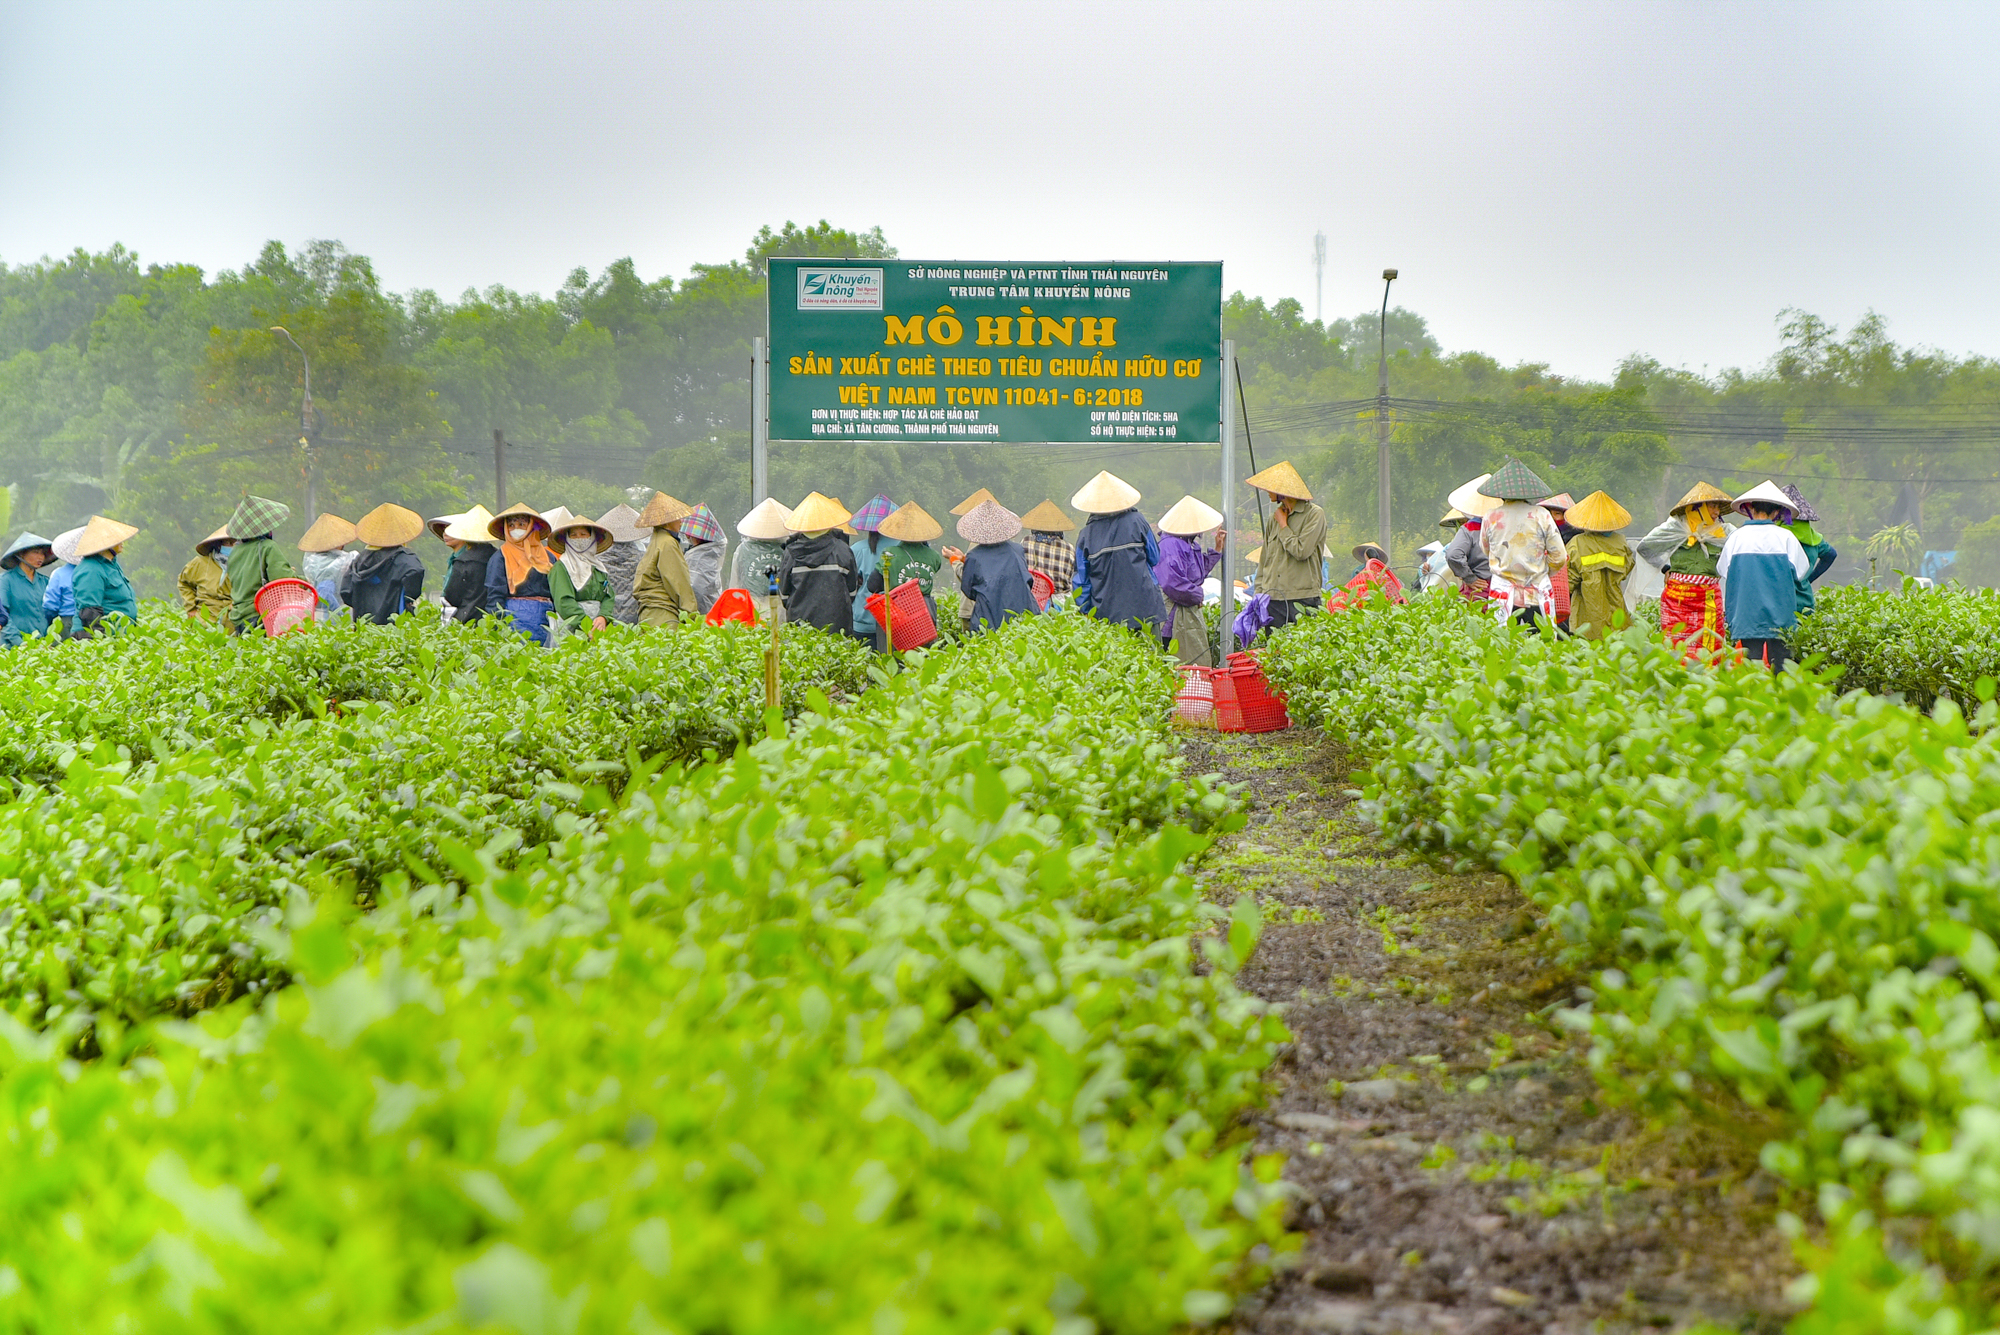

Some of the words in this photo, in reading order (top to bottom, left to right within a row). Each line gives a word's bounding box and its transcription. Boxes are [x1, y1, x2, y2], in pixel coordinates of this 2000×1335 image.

[829, 273, 871, 287] Khuyến
[908, 265, 925, 279] SỞ
[927, 267, 961, 279] NÔNG
[963, 267, 1007, 281] NGHIỆP
[1010, 267, 1026, 279] VÀ
[1028, 269, 1058, 280] PTNT
[1061, 266, 1088, 280] TỈNH
[1091, 268, 1118, 280] THÁI
[1120, 268, 1168, 280] NGUYÊN
[825, 285, 855, 298] nông
[948, 286, 995, 297] TRUNG
[999, 284, 1030, 297] TÂM
[1033, 283, 1090, 298] KHUYẾN
[1094, 284, 1131, 298] NÔNG
[883, 304, 963, 346] MÔ
[975, 306, 1117, 347] HÌNH
[789, 350, 833, 375] SẢN
[839, 351, 891, 375] XUẤT
[896, 354, 936, 376] CHÈ
[941, 357, 992, 376] THEO
[998, 355, 1042, 377] TIÊU
[1049, 351, 1118, 377] CHUẨN
[1125, 354, 1167, 378] HỮU
[1173, 358, 1202, 378] CƠ
[838, 382, 881, 407] VIỆT
[888, 386, 936, 405] NAM
[944, 386, 999, 405] TCVN
[1003, 387, 1058, 406] 11041
[811, 408, 829, 420] ĐƠN
[829, 409, 838, 421] VỊ
[838, 408, 860, 421] THỰC
[860, 407, 882, 421] HIỆN:
[882, 409, 899, 422] HỢP
[900, 407, 917, 420] TÁC
[917, 407, 929, 420] XÃ
[929, 407, 946, 420] CHÈ
[946, 405, 963, 420] HẢO
[964, 409, 980, 422] ĐẠT
[1090, 411, 1106, 422] QUY
[1107, 409, 1120, 421] MÔ
[1121, 409, 1141, 424] DIỆN
[1141, 409, 1162, 422] TÍCH:
[1162, 411, 1179, 422] 5HA
[811, 423, 826, 436] ĐỊA
[826, 420, 843, 434] CHỈ:
[843, 422, 855, 434] XÃ
[855, 422, 872, 434] TÂN
[873, 423, 903, 435] CƯƠNG,
[903, 422, 930, 434] THÀNH
[931, 421, 948, 434] PHỐ
[967, 422, 1000, 435] NGUYÊN
[1090, 422, 1102, 436] SỐ
[1102, 423, 1114, 438] HỘ
[1115, 425, 1135, 438] THỰC
[1136, 424, 1158, 438] HIỆN:
[1158, 426, 1164, 436] 5
[1165, 424, 1177, 438] HỘ
